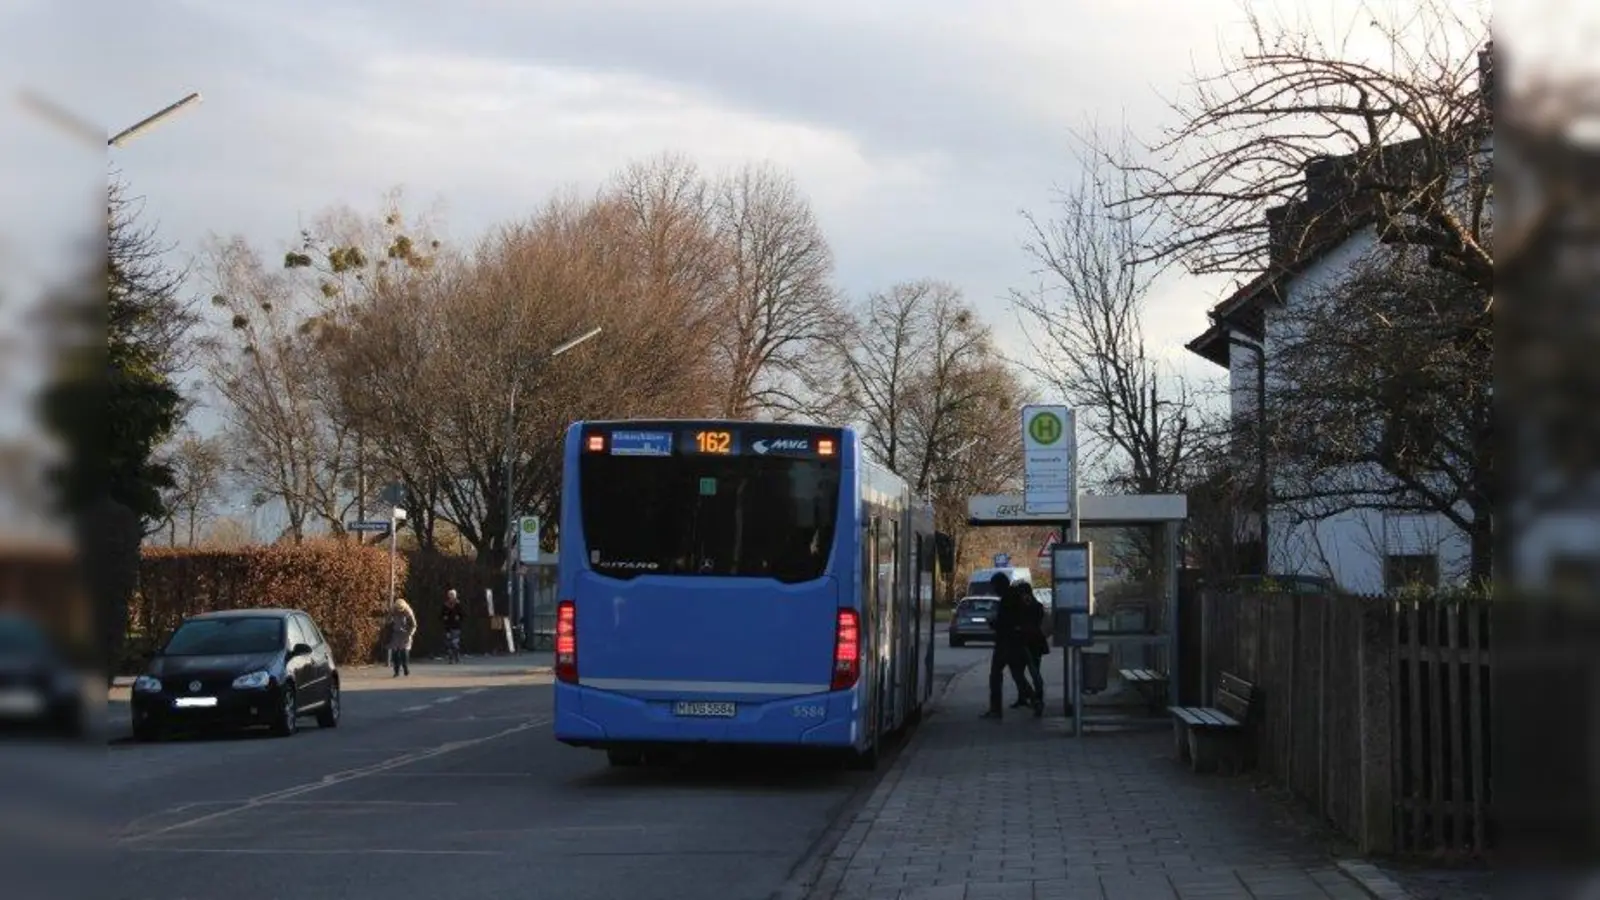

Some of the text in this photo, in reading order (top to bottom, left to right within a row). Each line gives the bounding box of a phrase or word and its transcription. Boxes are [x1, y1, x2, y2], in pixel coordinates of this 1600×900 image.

[1037, 419, 1054, 438] H
[696, 431, 730, 453] 162
[771, 438, 808, 449] MVG
[792, 705, 825, 718] 5584
